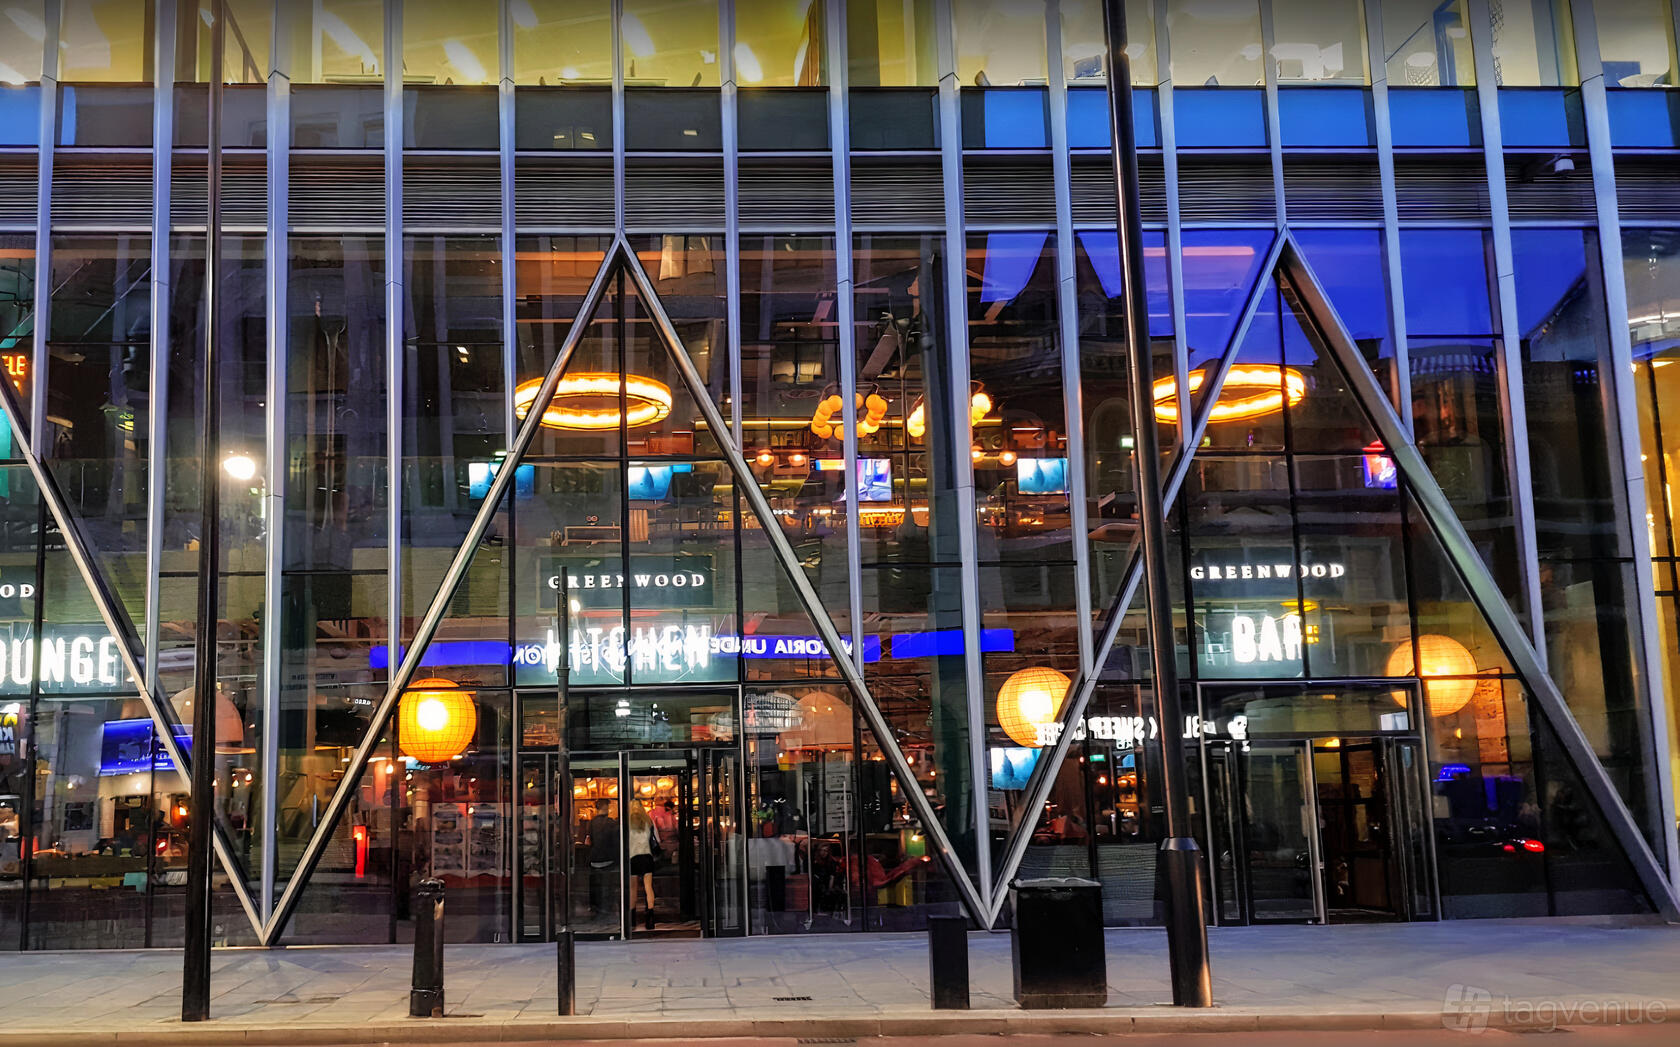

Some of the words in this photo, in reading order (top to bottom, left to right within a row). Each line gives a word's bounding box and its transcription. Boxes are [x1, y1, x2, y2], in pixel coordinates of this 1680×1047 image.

[1190, 564, 1345, 580] GREENWOOD
[0, 636, 116, 685] UNGE
[1232, 616, 1303, 663] BAR
